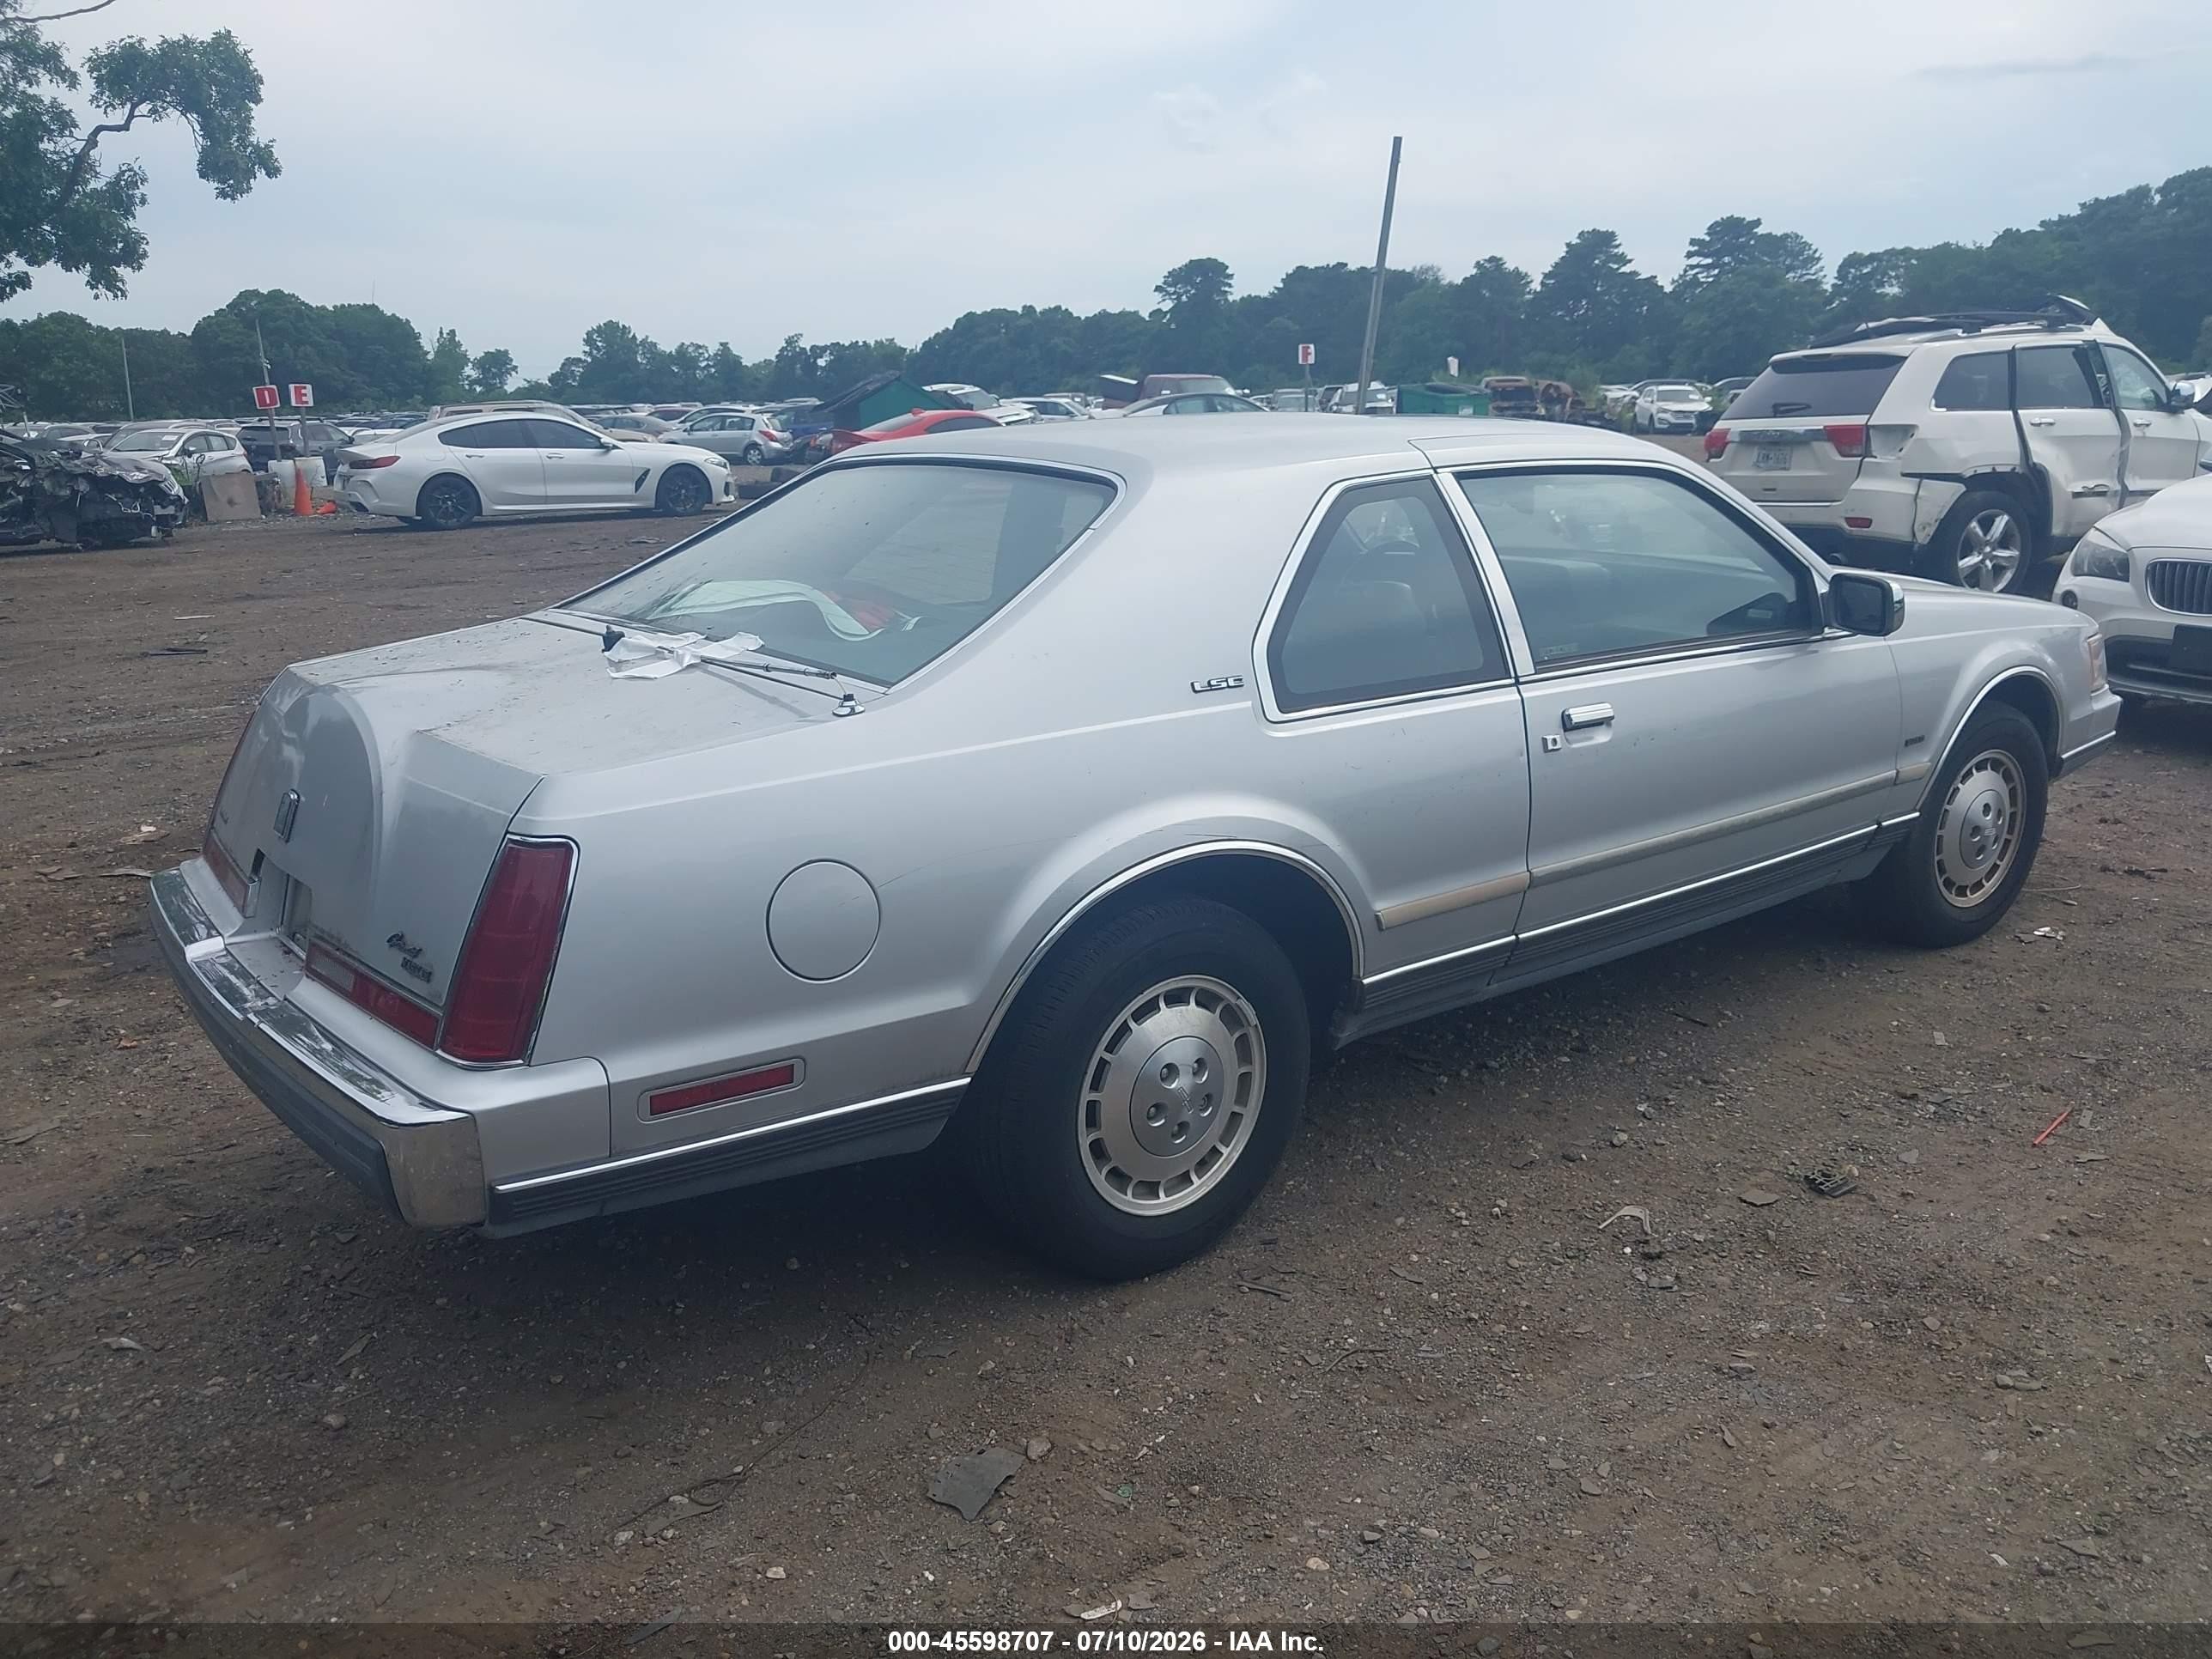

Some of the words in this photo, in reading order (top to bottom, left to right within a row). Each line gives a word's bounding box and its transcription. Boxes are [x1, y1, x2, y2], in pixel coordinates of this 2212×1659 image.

[1301, 345, 1312, 364] F
[294, 385, 310, 405] E
[1190, 675, 1244, 694] LSC
